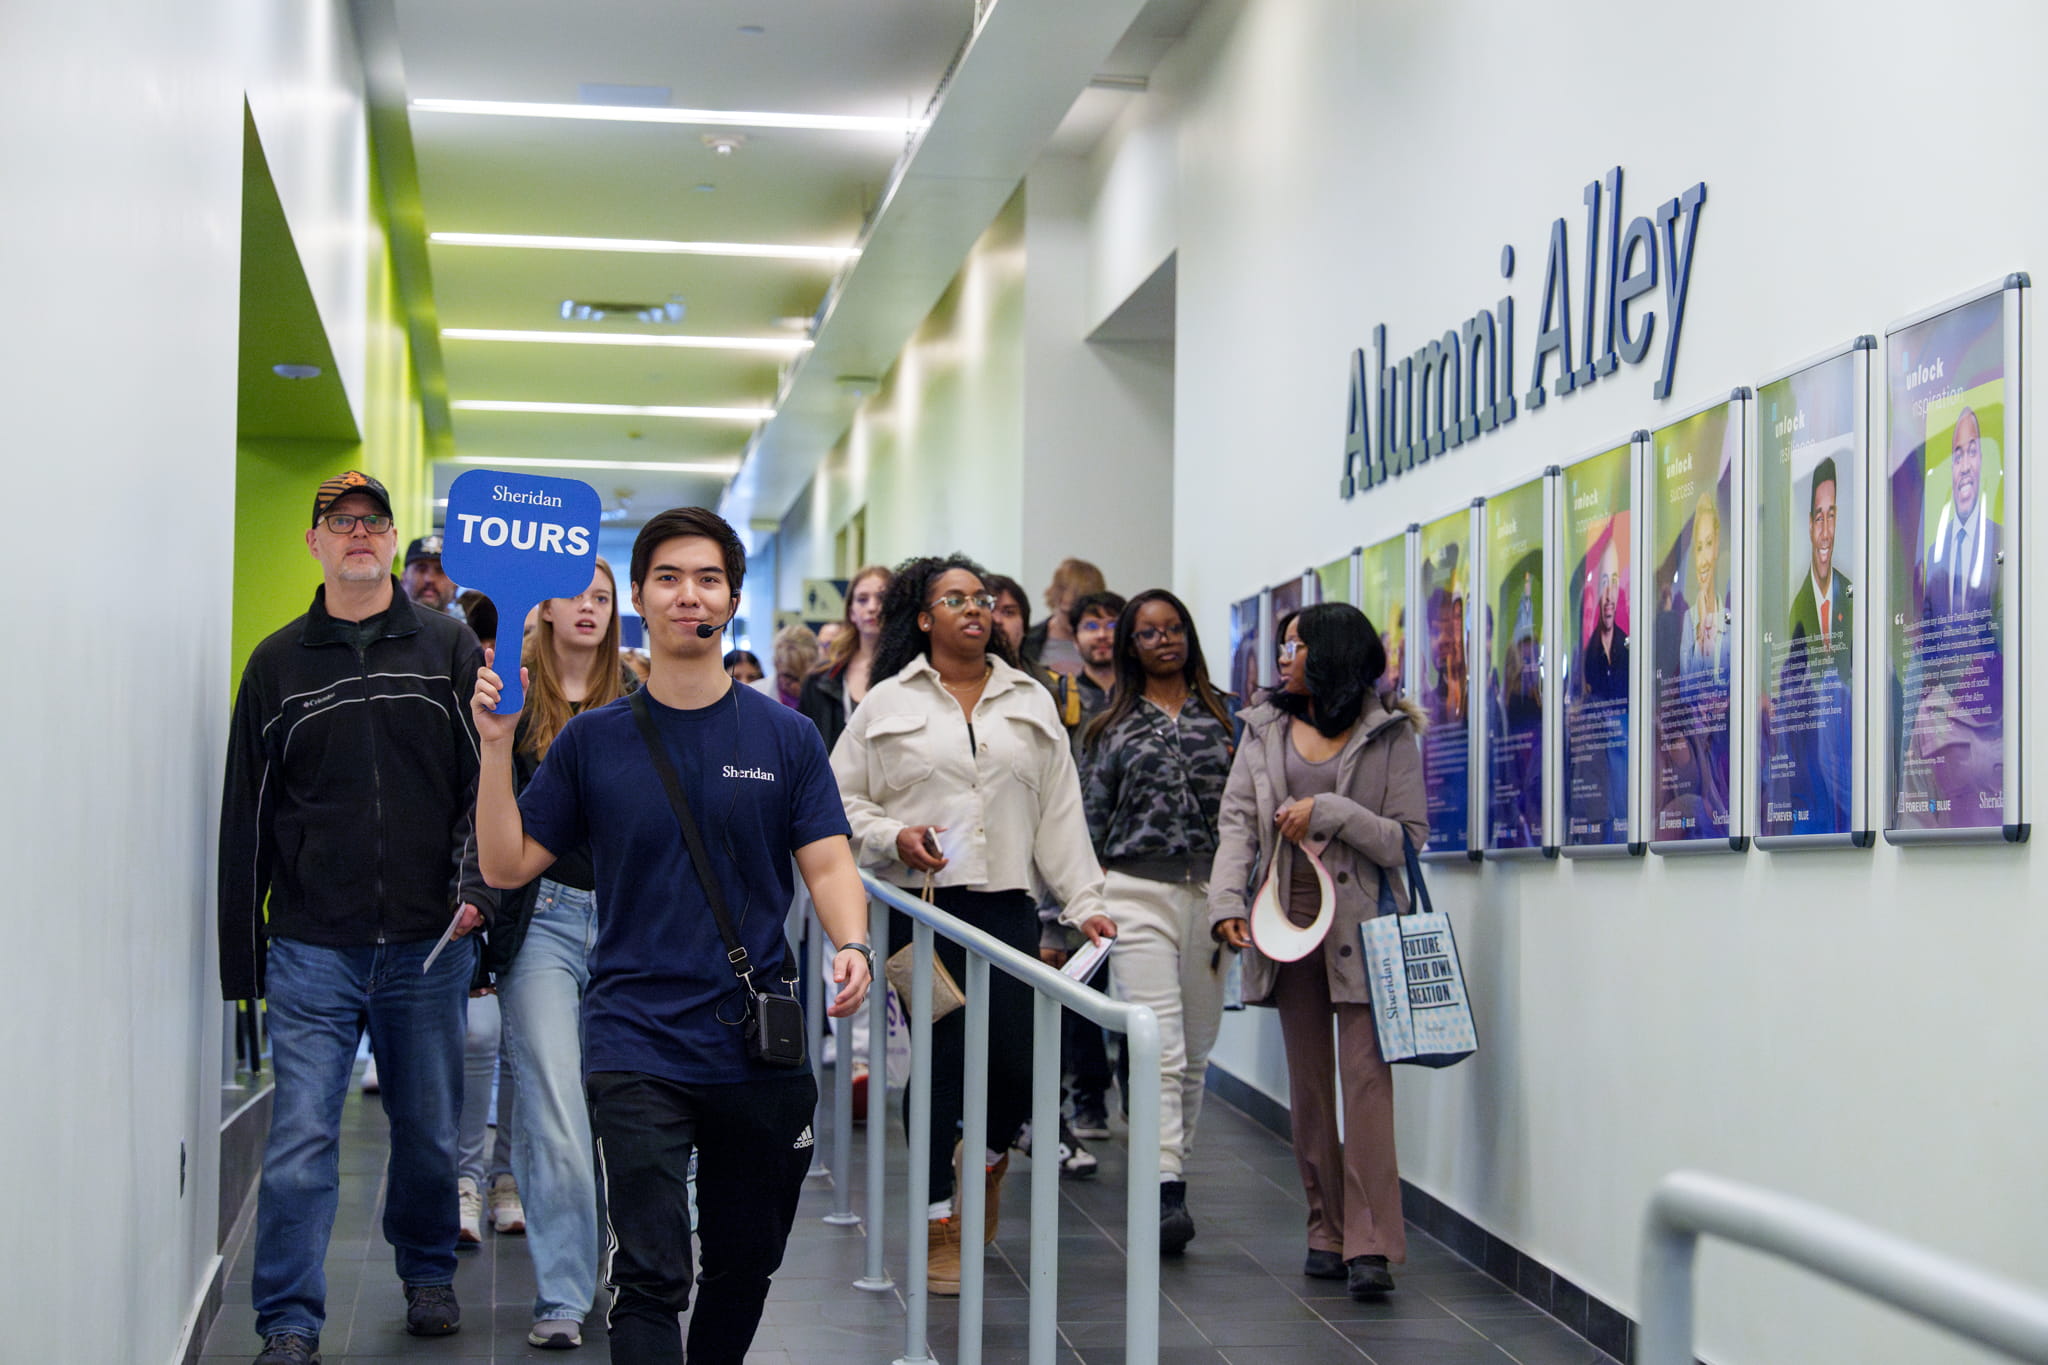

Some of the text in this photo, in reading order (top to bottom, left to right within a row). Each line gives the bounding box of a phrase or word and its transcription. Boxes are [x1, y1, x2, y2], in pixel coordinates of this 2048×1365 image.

[1340, 165, 1707, 499] Alumni Alley
[1906, 357, 1944, 391] unlock
[1775, 409, 1805, 438] unlock
[1666, 452, 1692, 479] unlock
[492, 485, 562, 508] Sheridan
[1574, 488, 1598, 511] unlock
[1670, 481, 1694, 504] success
[457, 513, 590, 556] TOURS
[722, 765, 775, 781] Sheridan
[1905, 799, 1951, 813] FOREVER BLUE
[1979, 790, 2004, 809] Sherid
[1712, 810, 1730, 825] Sherid
[1404, 935, 1441, 957] FUTURE
[1379, 957, 1399, 1020] Sheridan
[793, 1137, 815, 1150] adidas
